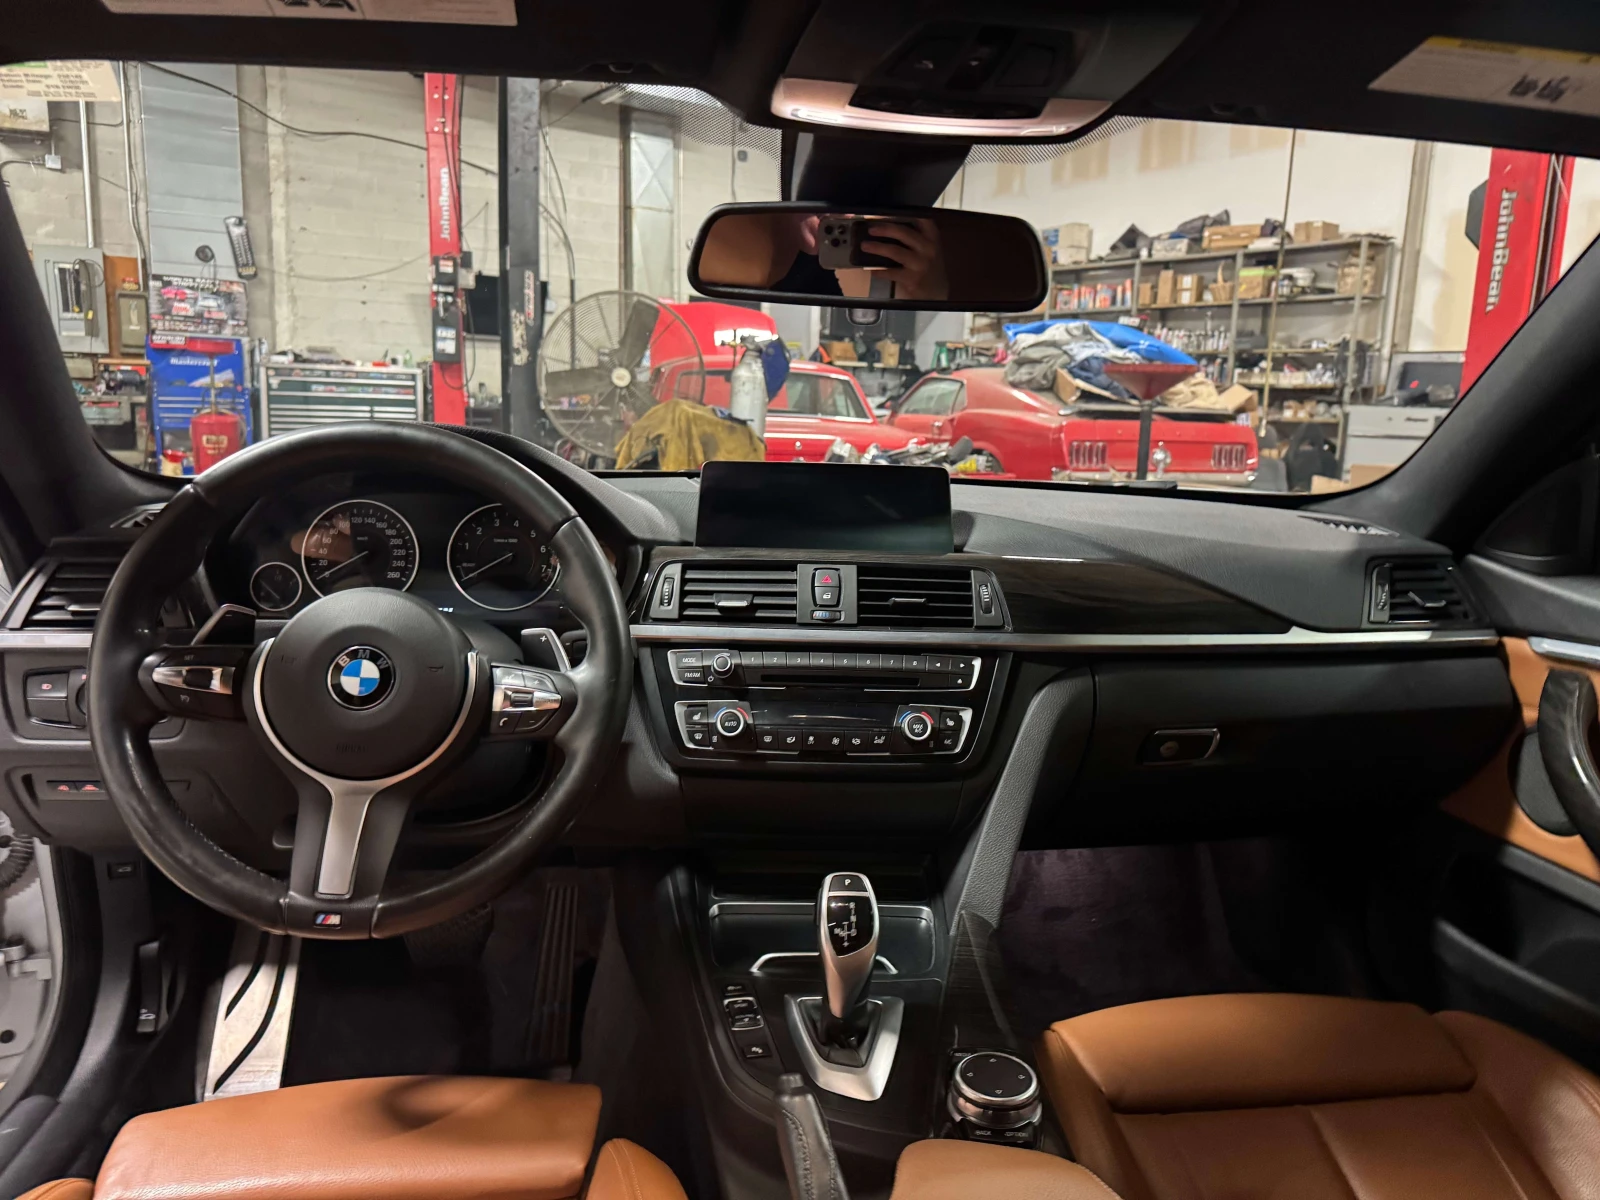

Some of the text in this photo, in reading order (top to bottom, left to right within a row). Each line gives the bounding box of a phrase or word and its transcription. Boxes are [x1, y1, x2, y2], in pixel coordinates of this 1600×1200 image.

[438, 167, 450, 241] JohnBean
[1485, 188, 1518, 314] JohnBean
[170, 357, 218, 367] Mastercrat
[494, 519, 500, 527] 3
[476, 527, 482, 535] 2
[530, 530, 536, 538] 5
[464, 542, 469, 550] 1
[540, 545, 546, 553] 6
[541, 565, 546, 573] 7
[387, 571, 400, 579] 260
[338, 649, 390, 669] BMW
[844, 878, 851, 886] P
